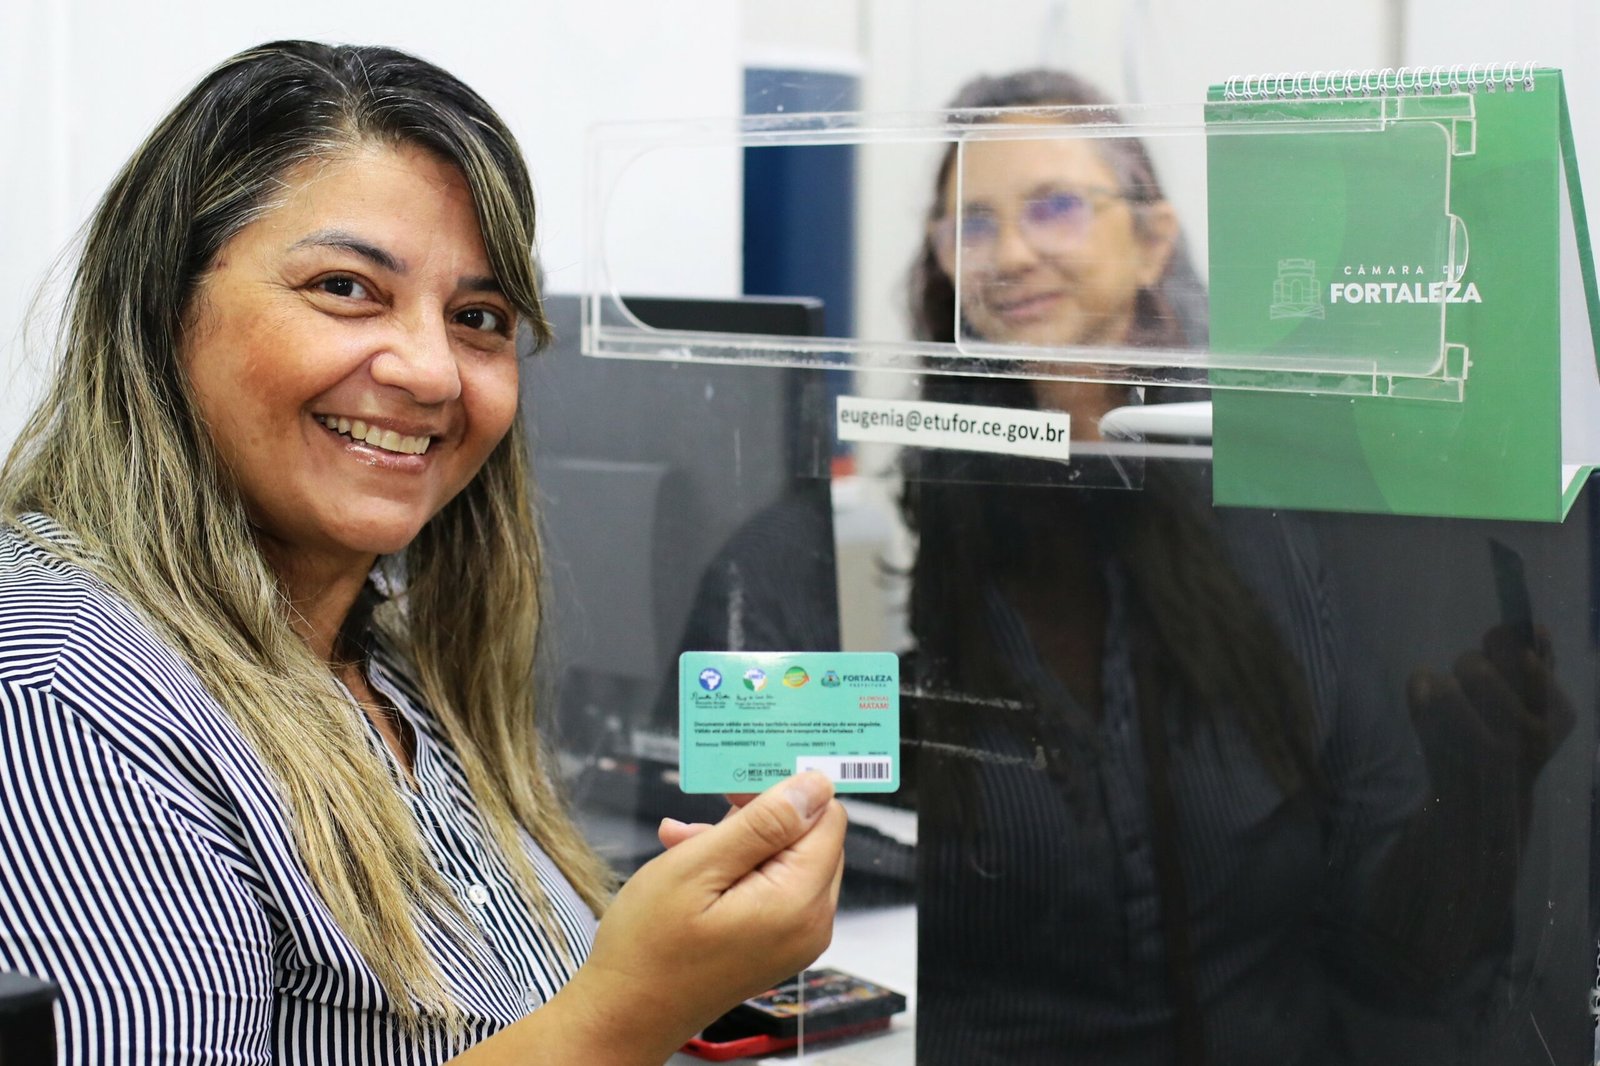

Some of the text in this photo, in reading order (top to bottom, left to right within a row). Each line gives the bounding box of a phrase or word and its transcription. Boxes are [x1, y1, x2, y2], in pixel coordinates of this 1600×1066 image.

[1344, 264, 1424, 275] CÂMARA
[1330, 281, 1482, 304] FORTALEZA
[840, 409, 1065, 444] eugenia@etufor.ce.gov.br
